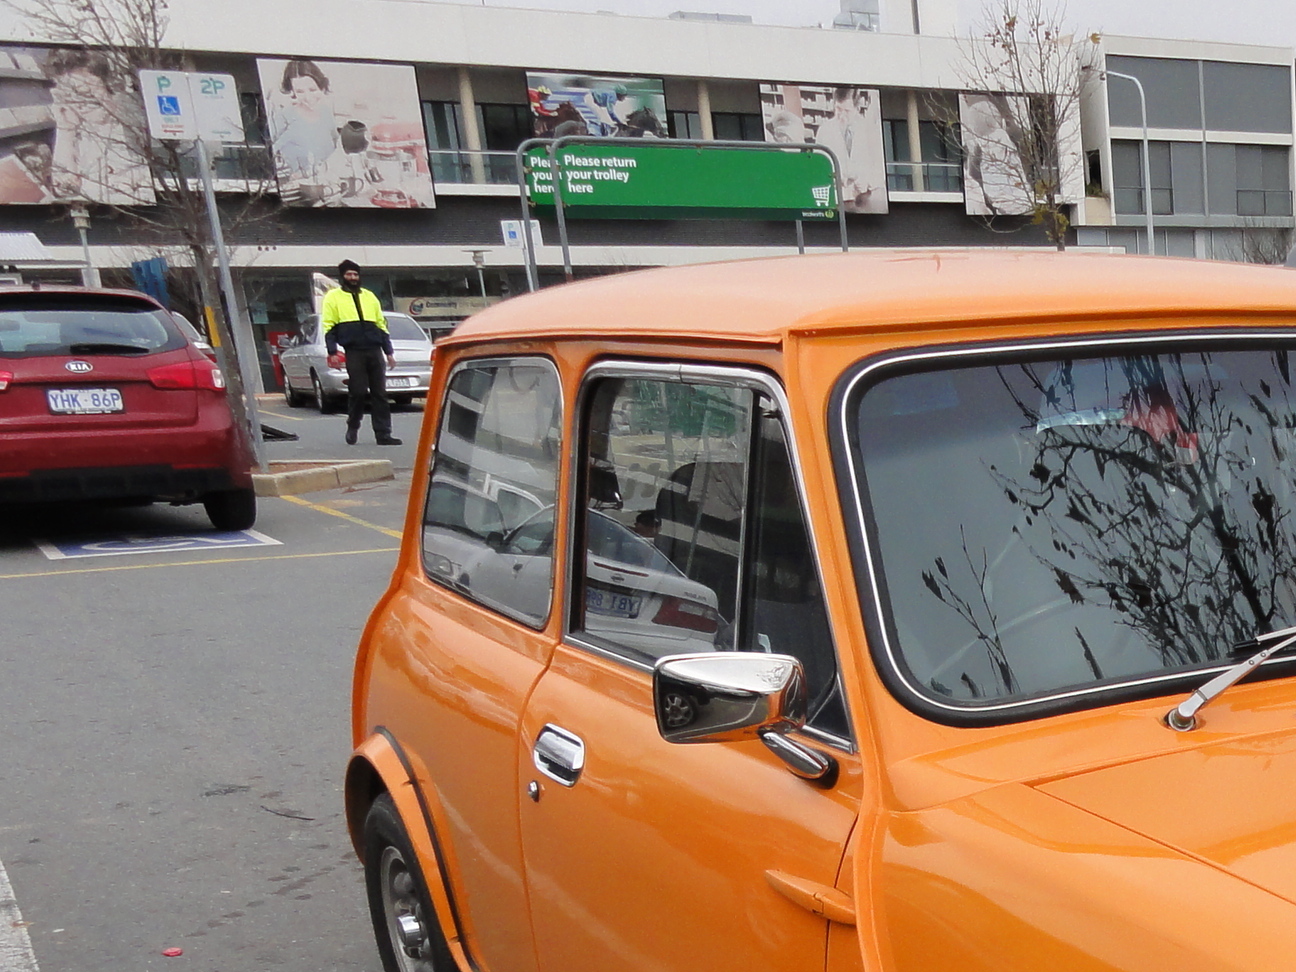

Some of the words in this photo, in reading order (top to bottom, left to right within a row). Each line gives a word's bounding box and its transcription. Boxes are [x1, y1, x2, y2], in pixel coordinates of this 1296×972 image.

[157, 77, 171, 93] P
[200, 79, 225, 95] 2P
[563, 154, 600, 167] Please
[602, 157, 637, 168] return
[532, 172, 553, 182] you
[566, 171, 591, 182] your
[593, 169, 629, 184] trolley
[567, 182, 594, 194] here
[69, 363, 91, 371] KIA
